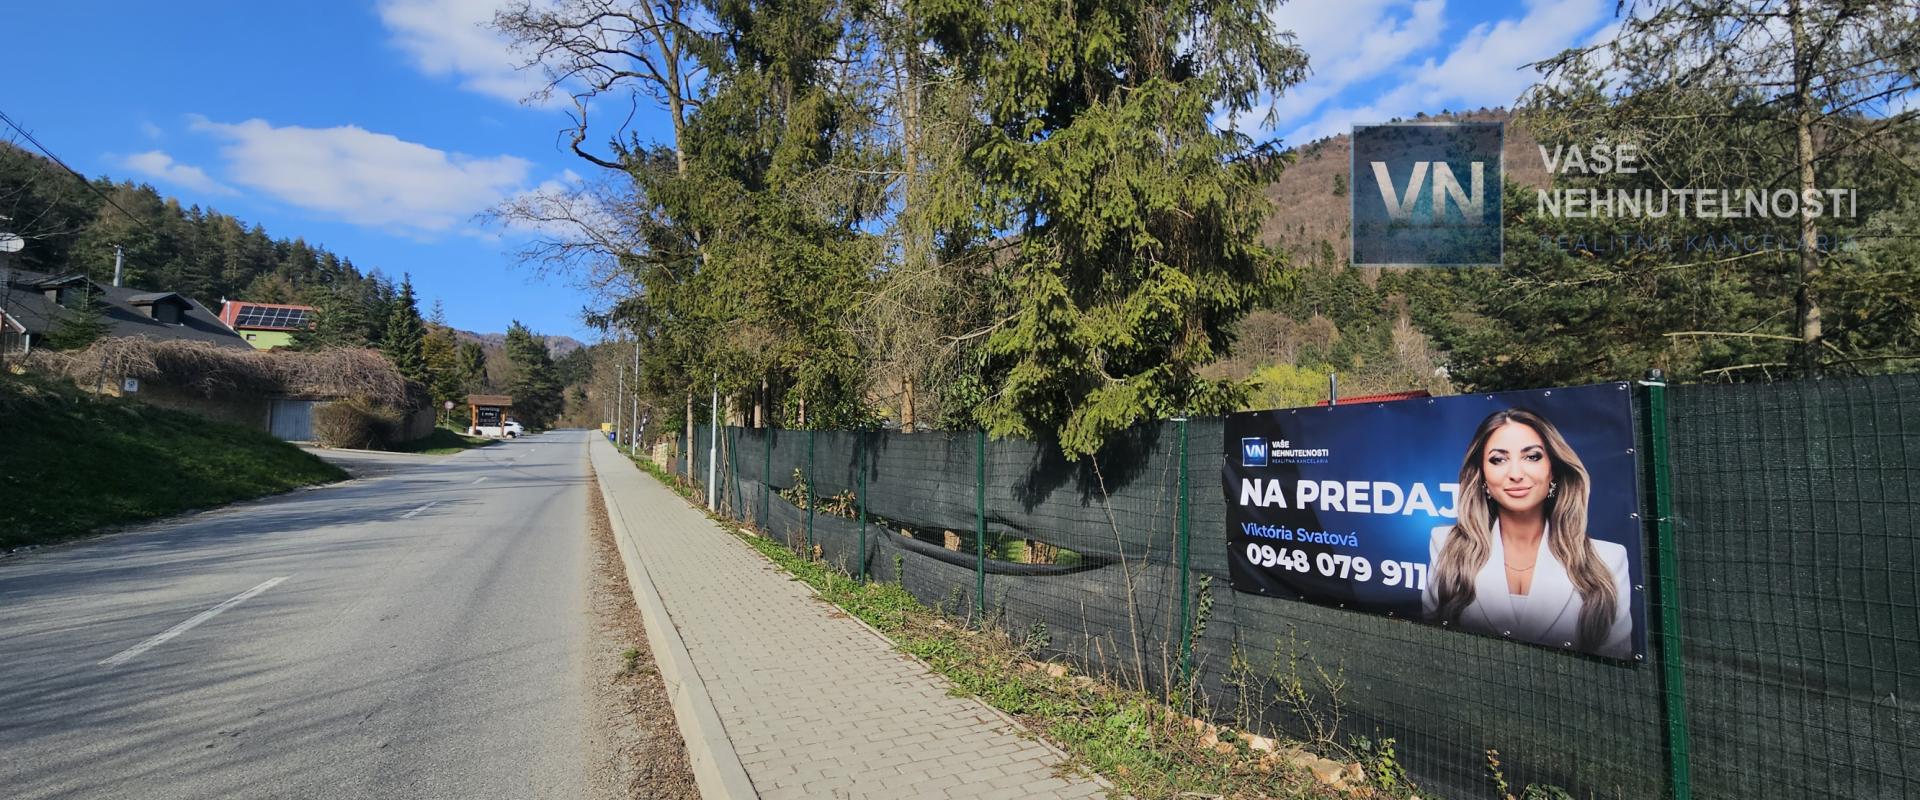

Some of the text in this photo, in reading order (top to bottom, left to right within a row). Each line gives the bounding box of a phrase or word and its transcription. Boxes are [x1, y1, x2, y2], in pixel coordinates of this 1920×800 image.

[1245, 444, 1265, 458] VN
[1271, 439, 1290, 449] VAŠE
[1239, 478, 1460, 518] NA PREDAJ
[1241, 522, 1358, 547] Viktória Svatová
[1246, 542, 1427, 591] 0948 079 911
